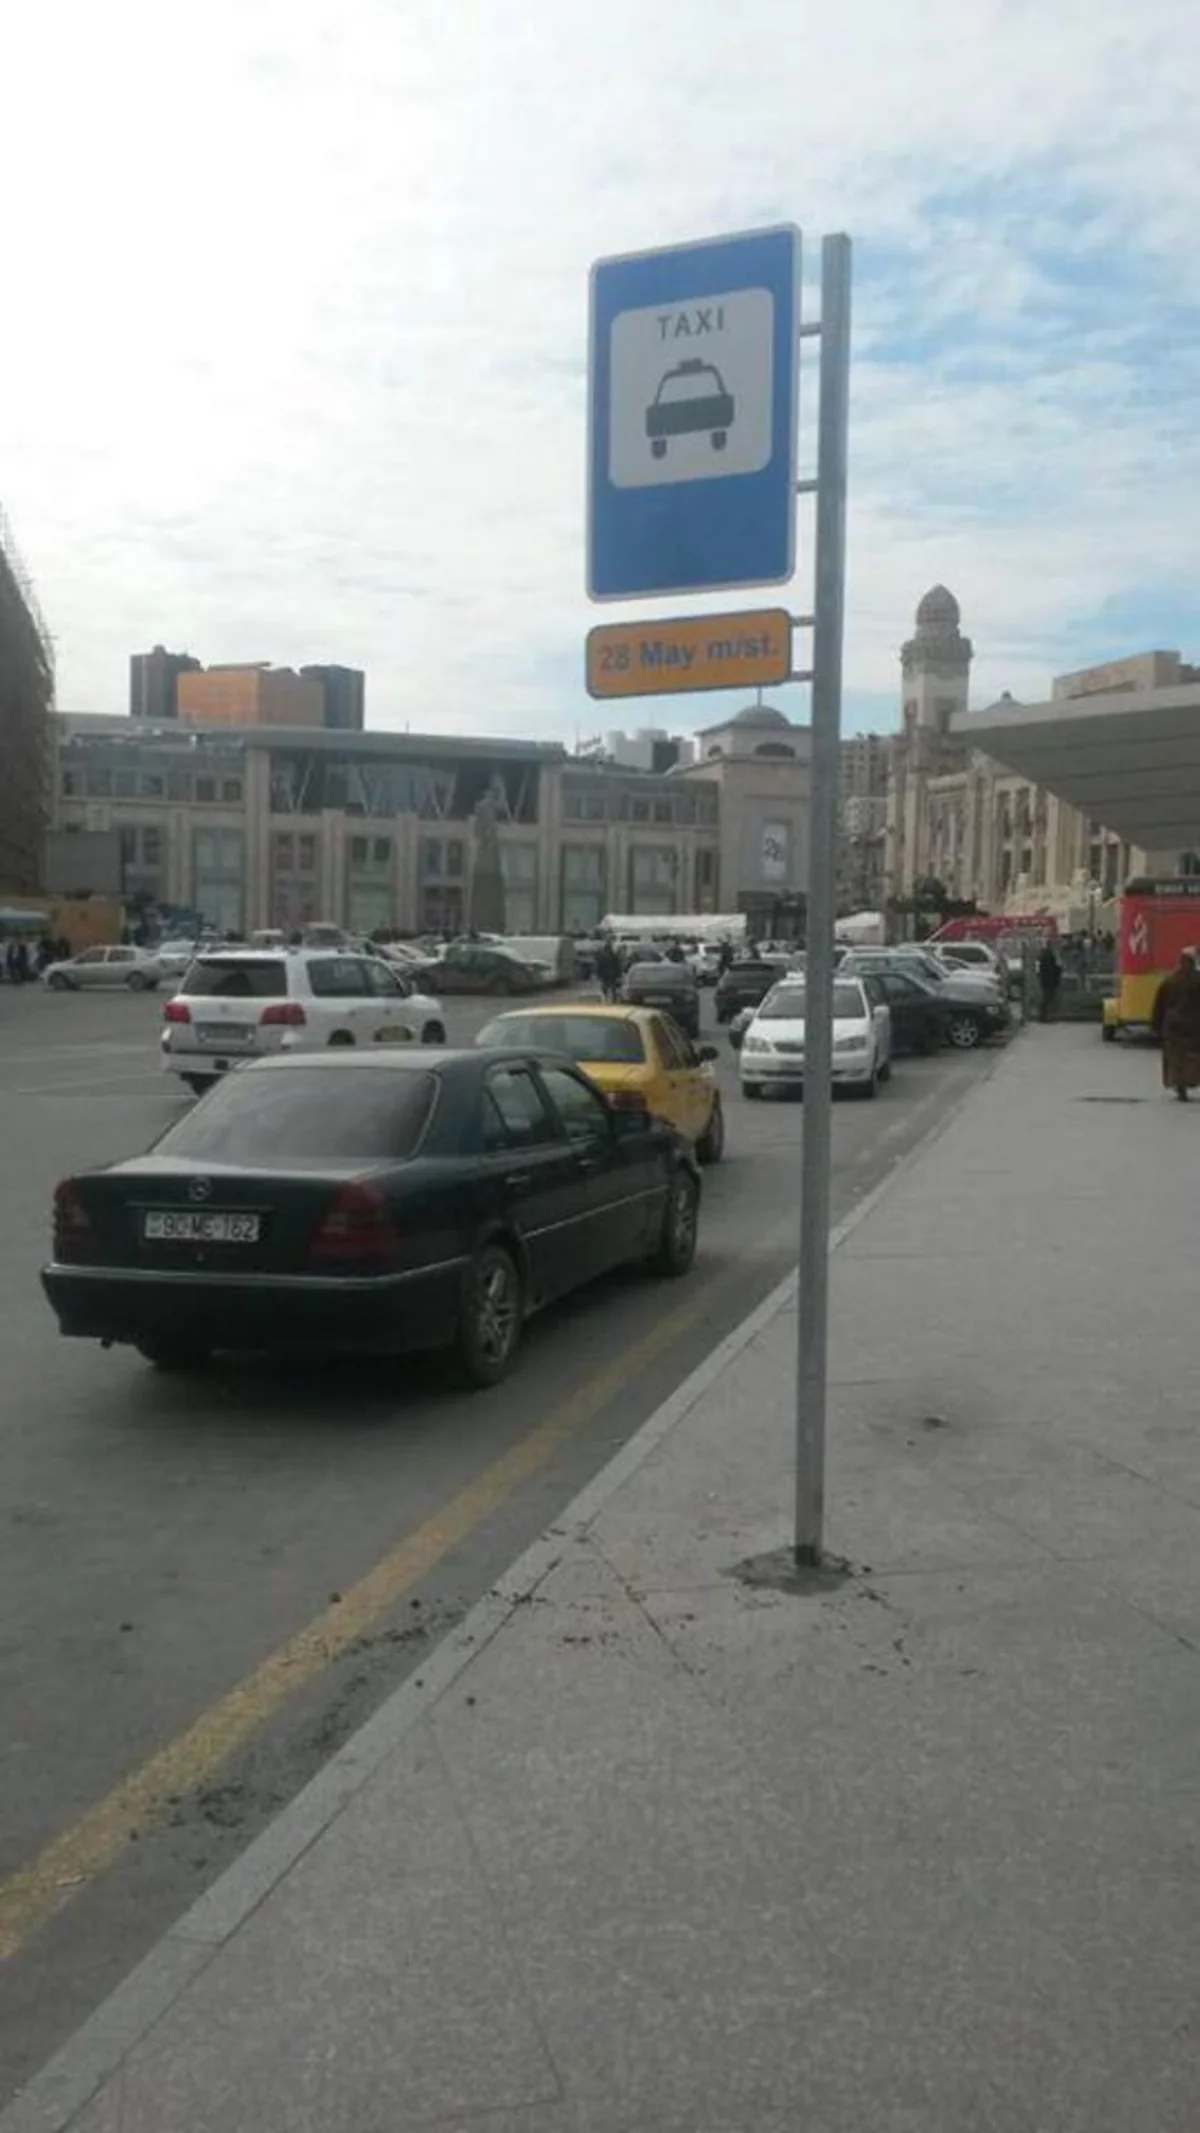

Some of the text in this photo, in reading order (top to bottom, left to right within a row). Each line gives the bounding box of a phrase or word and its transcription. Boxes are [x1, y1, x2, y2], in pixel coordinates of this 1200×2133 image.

[657, 307, 724, 340] TAXI
[599, 631, 780, 671] 28 May m/st.
